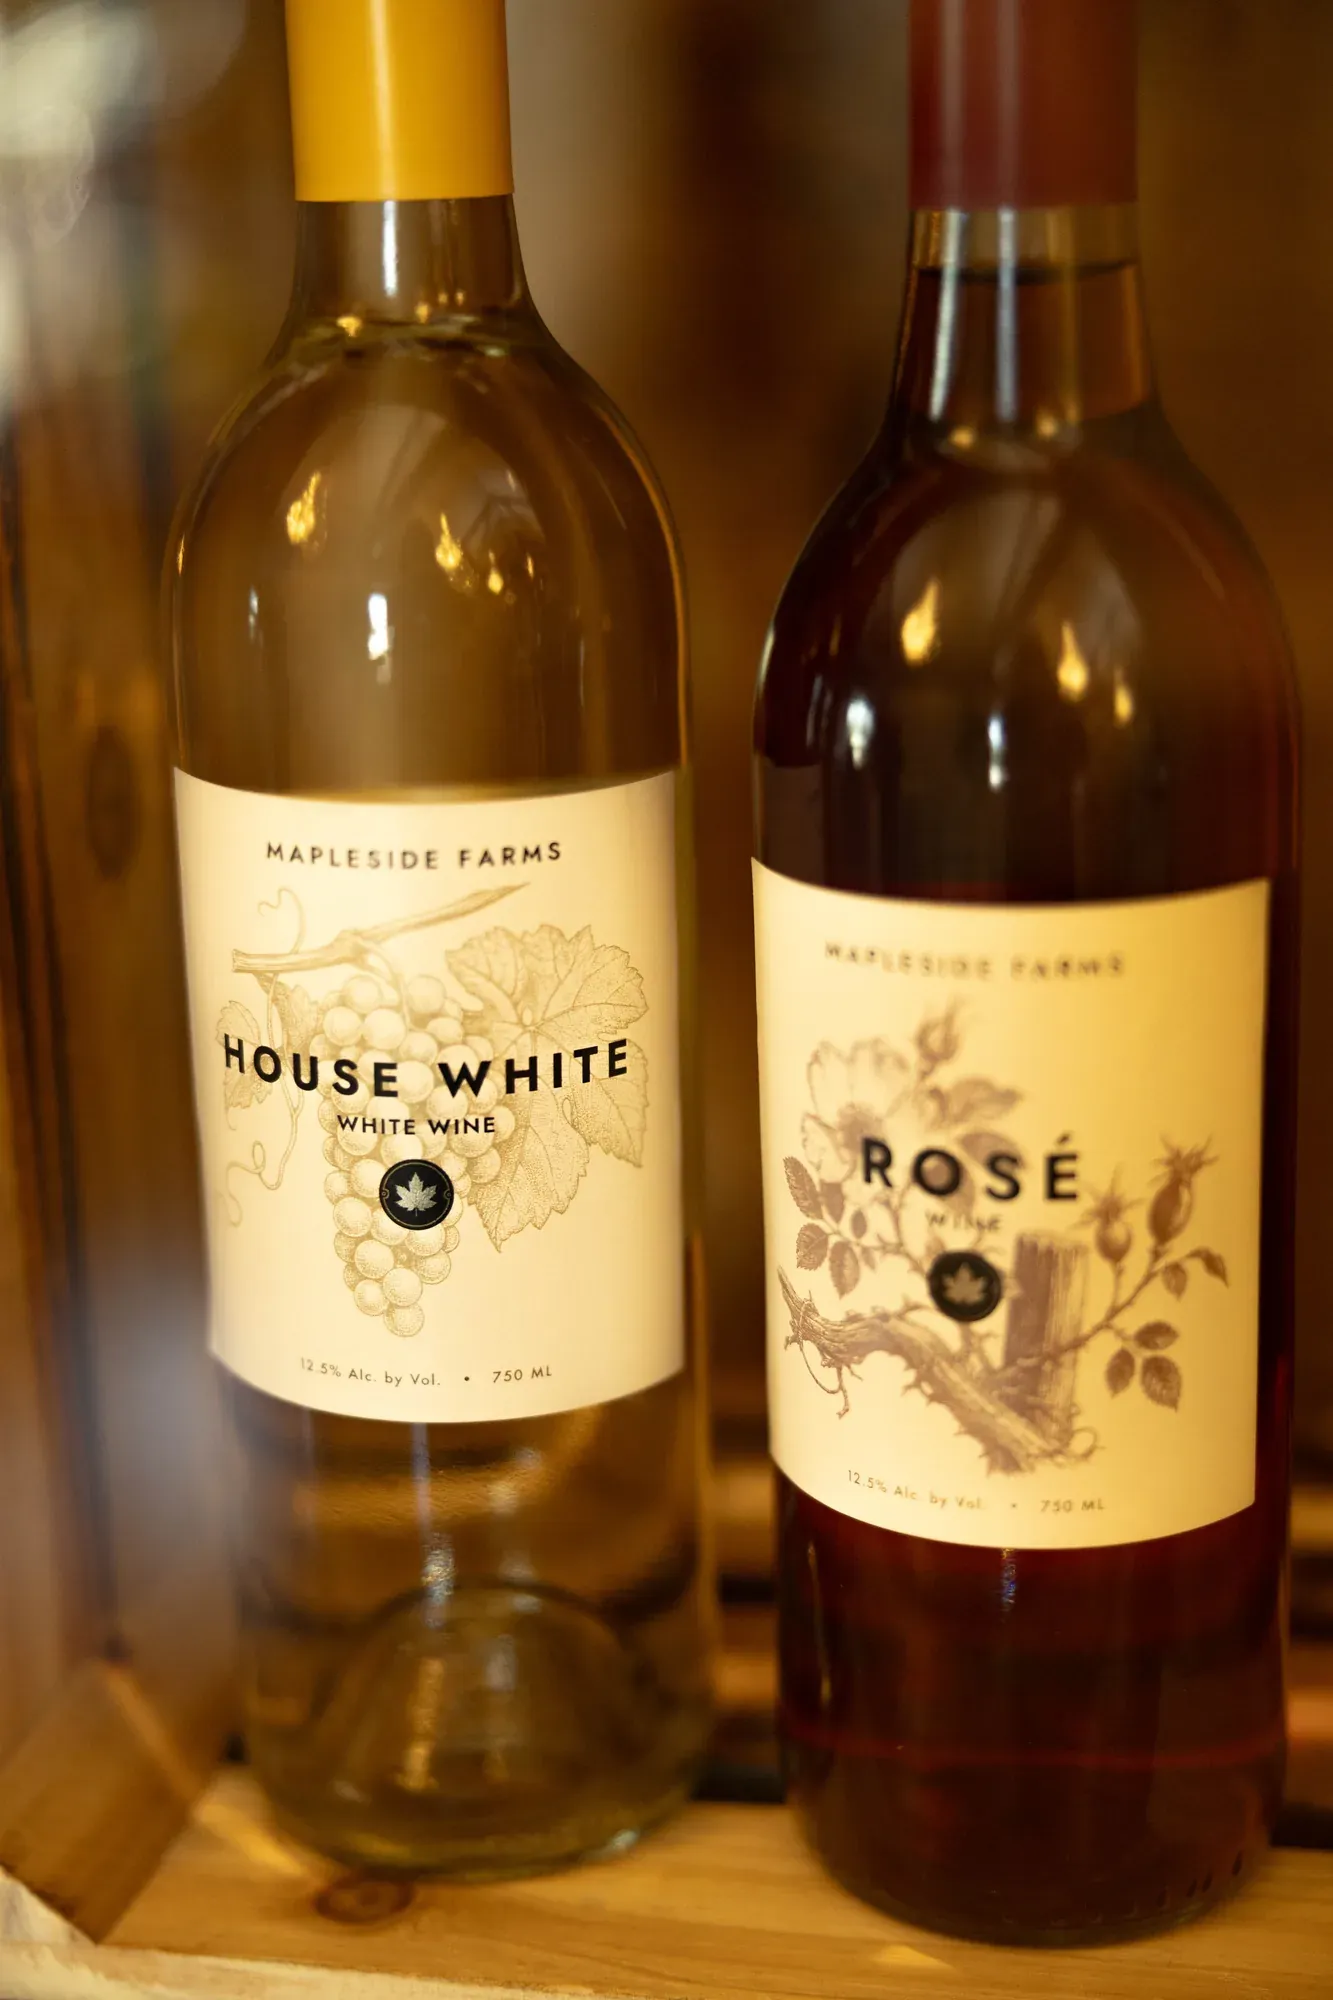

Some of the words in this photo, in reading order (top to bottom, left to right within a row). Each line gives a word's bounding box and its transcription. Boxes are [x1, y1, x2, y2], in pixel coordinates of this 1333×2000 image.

[266, 841, 439, 870] MAPLESIDE
[459, 841, 562, 868] FARMS
[825, 940, 993, 980] MAPLESIDE
[1010, 951, 1126, 980] FARMS
[223, 1033, 399, 1098] HOUSE
[437, 1038, 628, 1098] WHITE
[337, 1114, 416, 1136] WHITE
[427, 1116, 496, 1136] WINE
[860, 1132, 1080, 1202] ROSÉ
[348, 1368, 377, 1383] Alc.
[384, 1371, 402, 1387] by
[410, 1373, 441, 1386] Vol.
[492, 1369, 523, 1383] 750
[531, 1365, 553, 1380] ML
[847, 1469, 888, 1493] 12.5%
[929, 1491, 948, 1509] by
[1041, 1499, 1073, 1513] 750
[1081, 1498, 1105, 1512] ML
